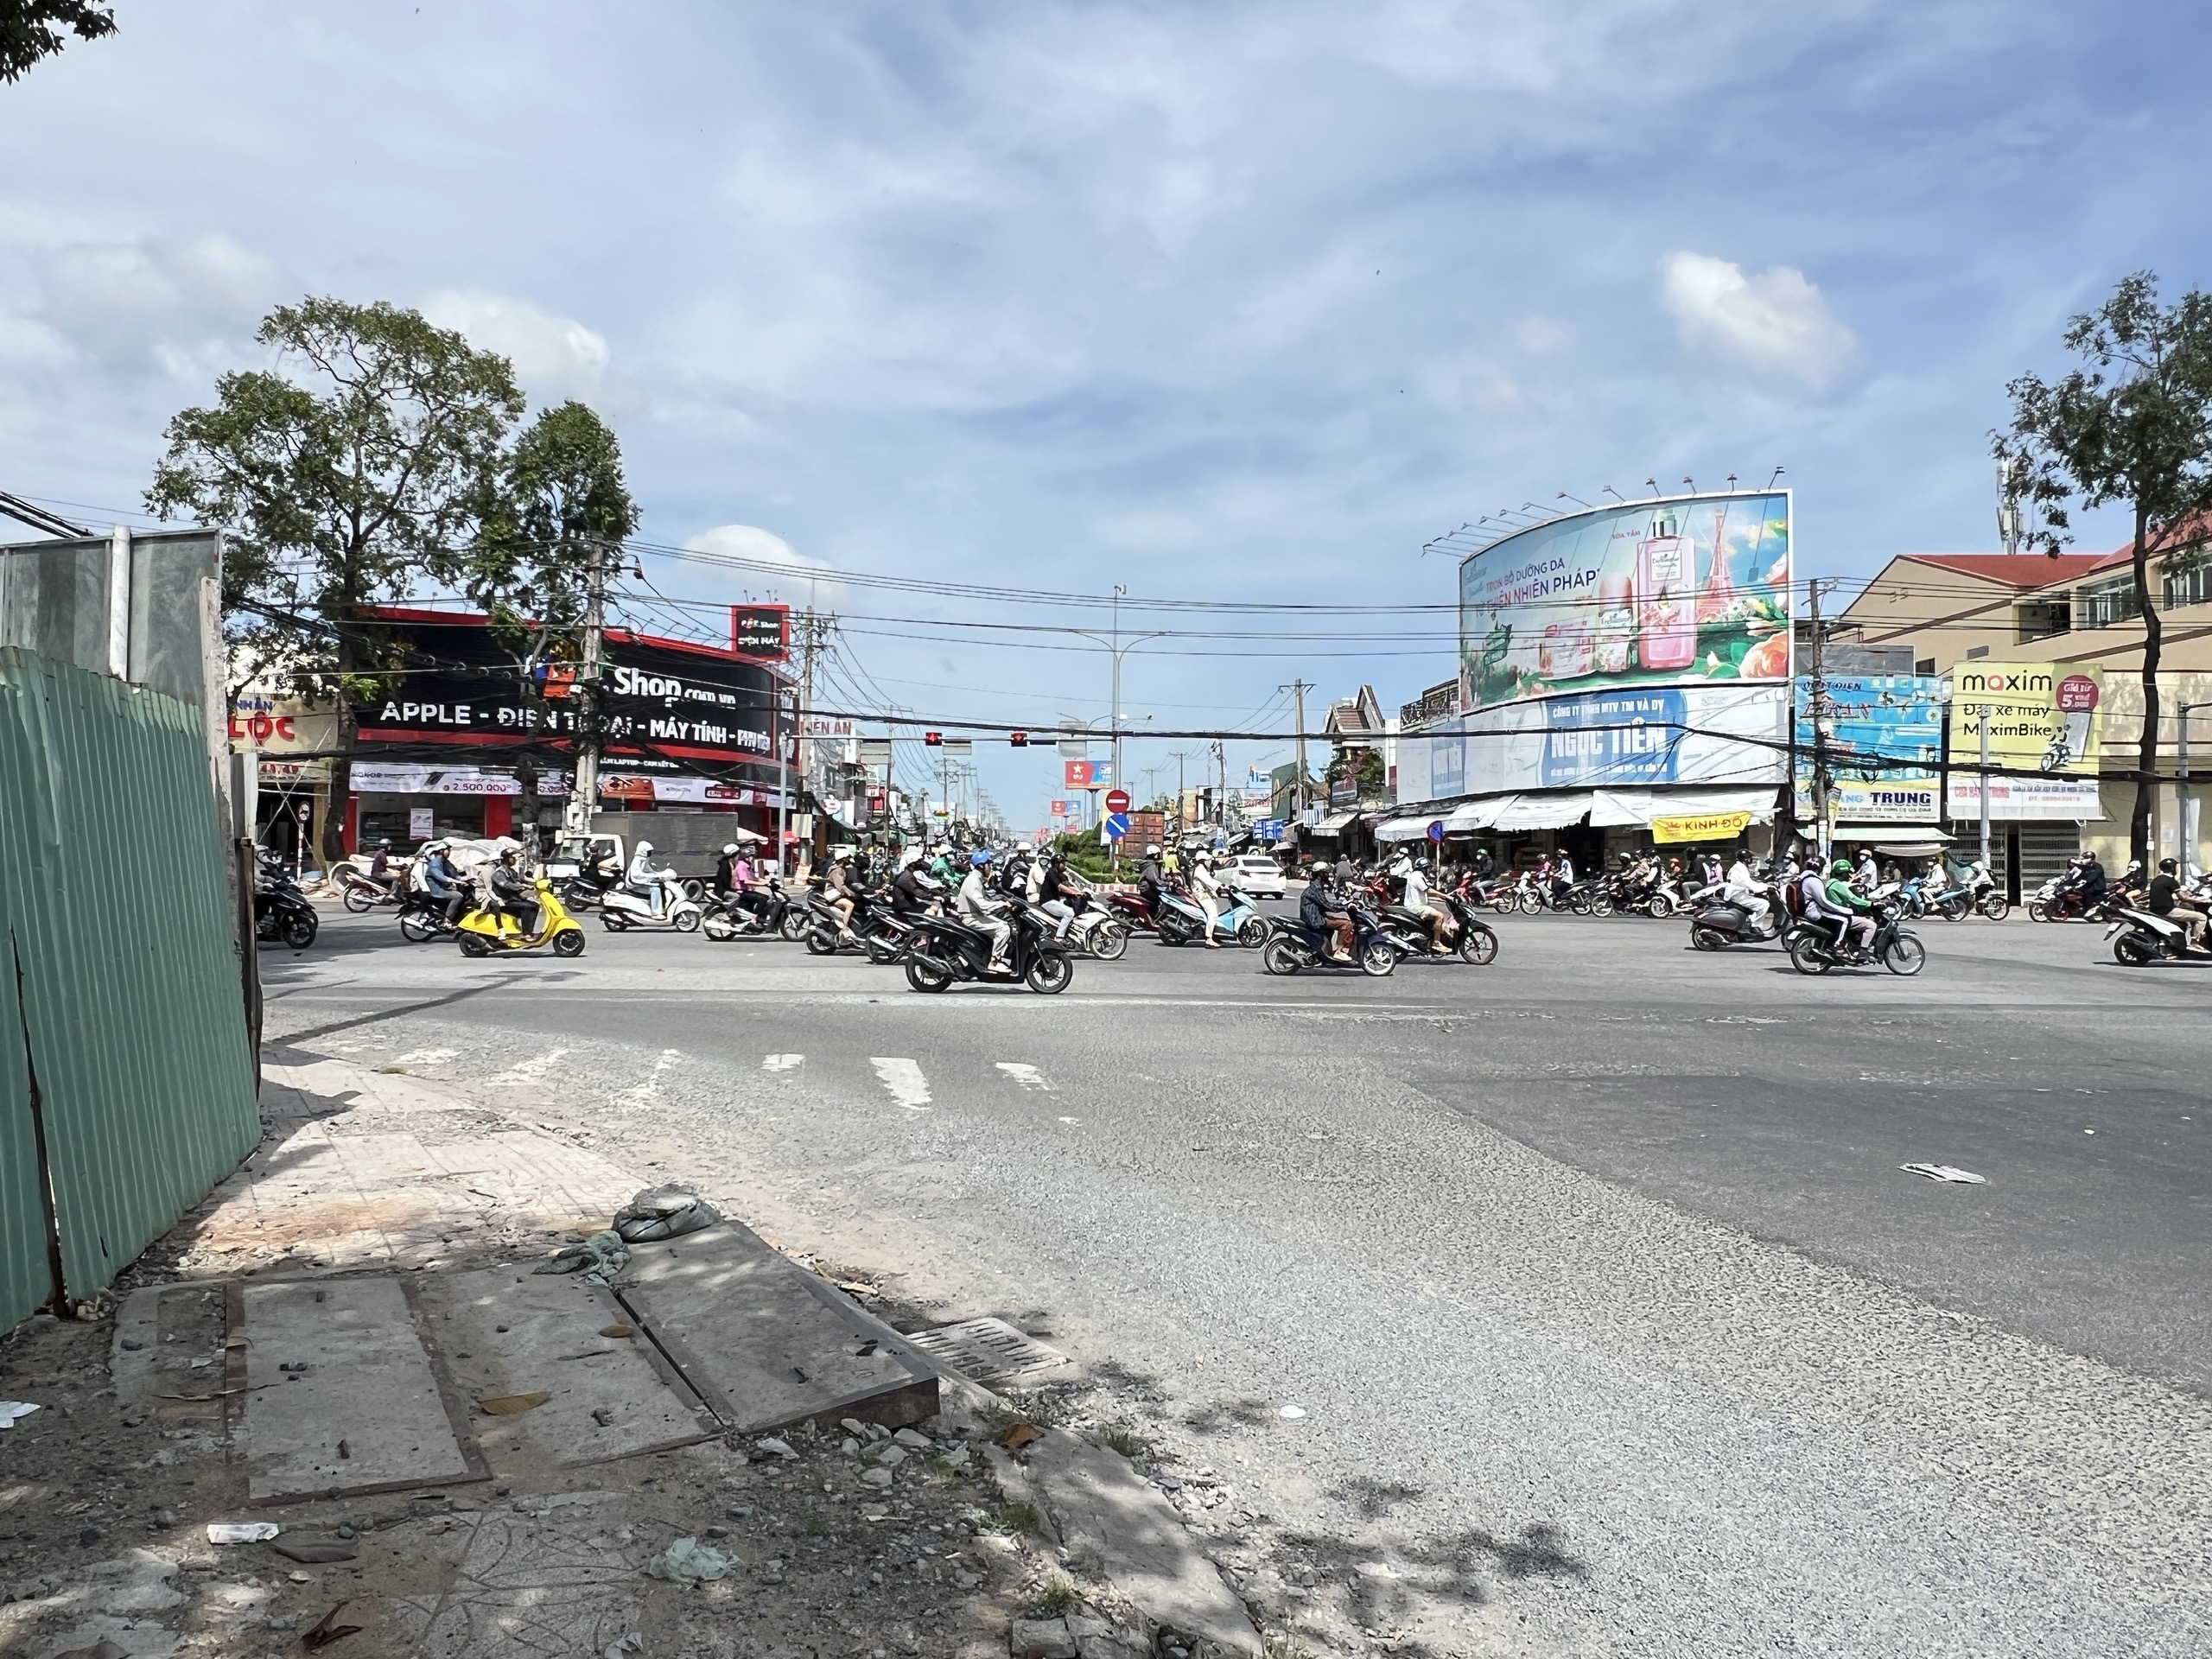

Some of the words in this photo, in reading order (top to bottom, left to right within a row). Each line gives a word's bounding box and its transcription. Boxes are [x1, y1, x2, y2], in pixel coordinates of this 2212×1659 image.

[1550, 557, 1565, 572] DA
[1514, 578, 1549, 604] NHIÊN
[613, 667, 682, 708] Shop
[1962, 670, 2052, 691] maxim
[1621, 699, 1635, 712] TM
[1637, 697, 1649, 711] VÀ
[1652, 698, 1665, 711] DV
[1996, 706, 2012, 716] xe
[2018, 703, 2050, 718] máy
[228, 711, 296, 747] LỘC
[380, 702, 472, 724] APPLE
[650, 716, 690, 740] MÁY
[691, 721, 727, 744] TÍNH
[1963, 723, 2052, 736] MximBike
[1869, 791, 1932, 806] TRUNG
[1684, 819, 1717, 831] KINH
[1717, 815, 1744, 830] ĐÔ
